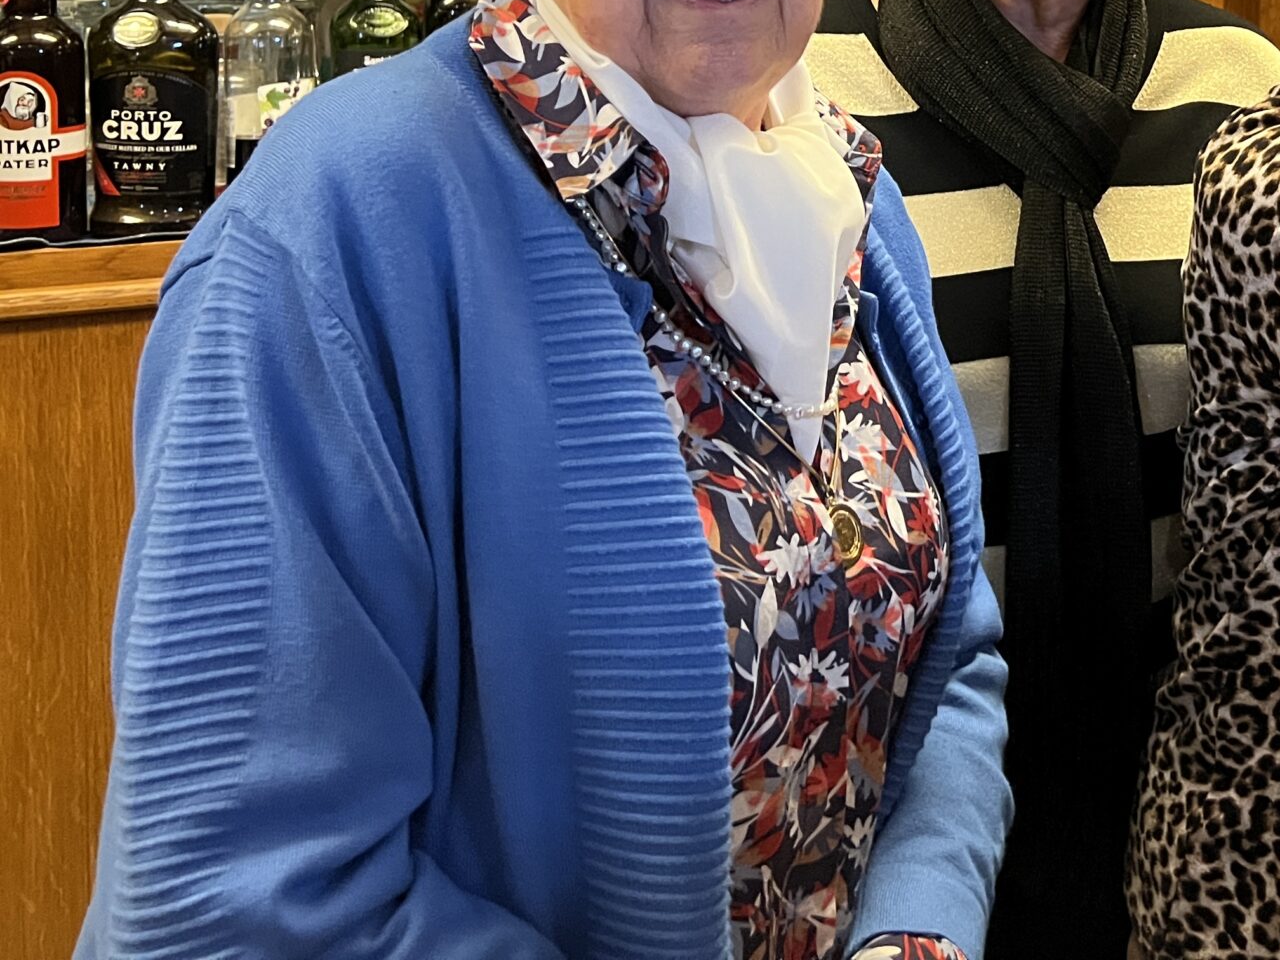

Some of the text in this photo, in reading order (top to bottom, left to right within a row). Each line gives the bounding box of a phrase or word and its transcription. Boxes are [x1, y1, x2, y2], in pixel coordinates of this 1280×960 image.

[110, 109, 172, 121] PORTO
[102, 119, 184, 141] CRUZ
[0, 138, 61, 155] ITKAP
[0, 158, 49, 169] ATER
[113, 161, 167, 171] TAWNY
